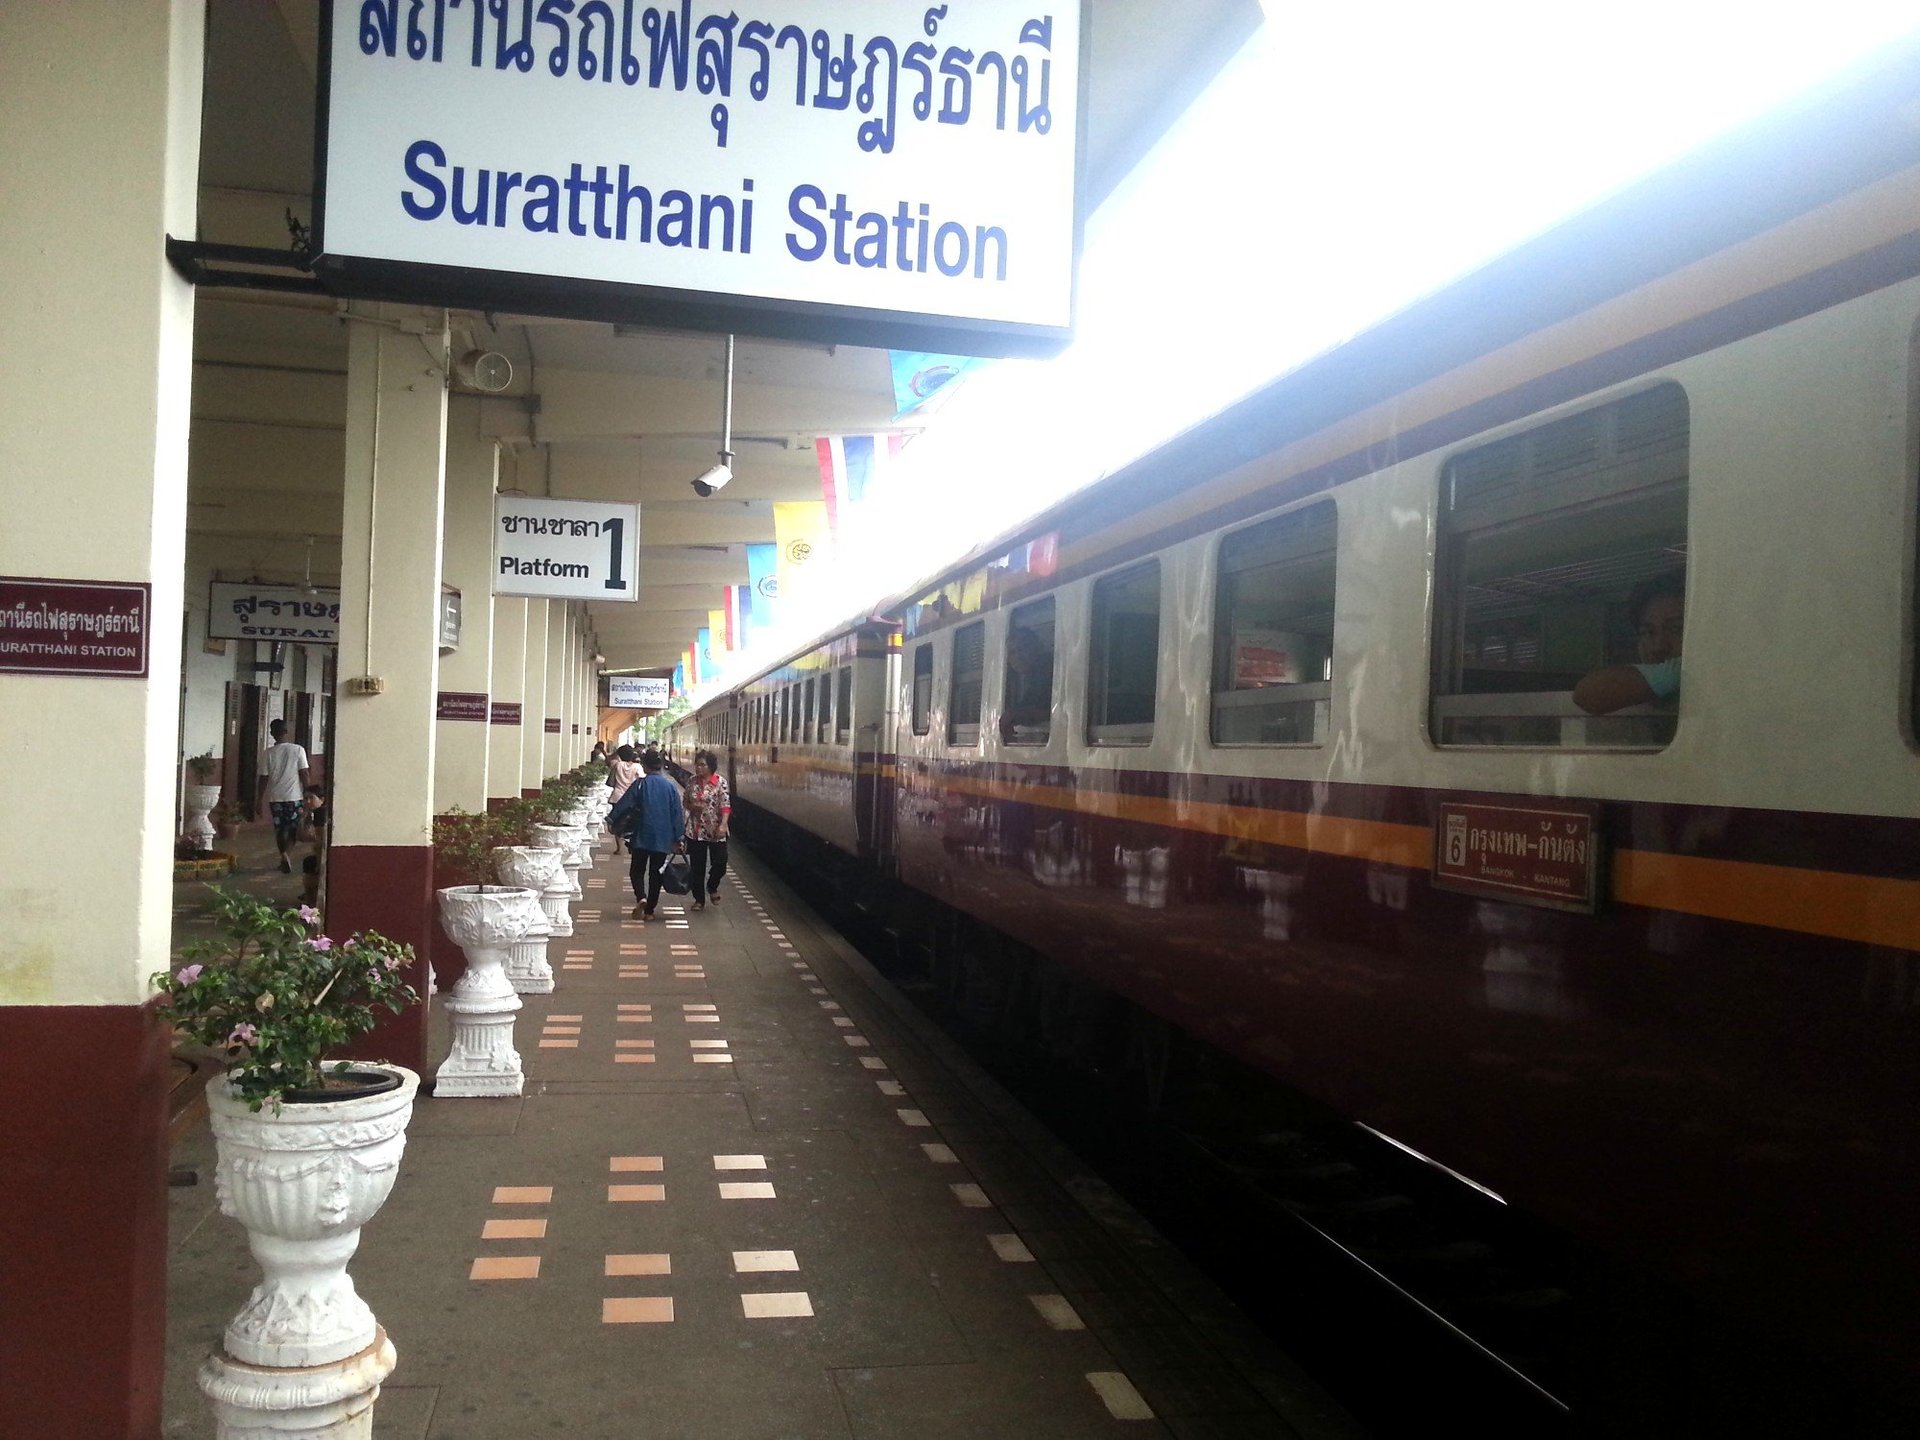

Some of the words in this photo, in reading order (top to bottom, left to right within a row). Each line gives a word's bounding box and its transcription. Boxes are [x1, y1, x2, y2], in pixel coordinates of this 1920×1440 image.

[401, 140, 754, 254] Suratthani
[785, 184, 1007, 281] Station
[502, 515, 599, 537] ชานชาลา
[602, 517, 627, 590] 1
[500, 556, 589, 578] Platform
[242, 626, 334, 639] SURAT
[0, 643, 77, 655] URATTHANI
[81, 646, 136, 657] STATION
[1451, 835, 1461, 863] 6
